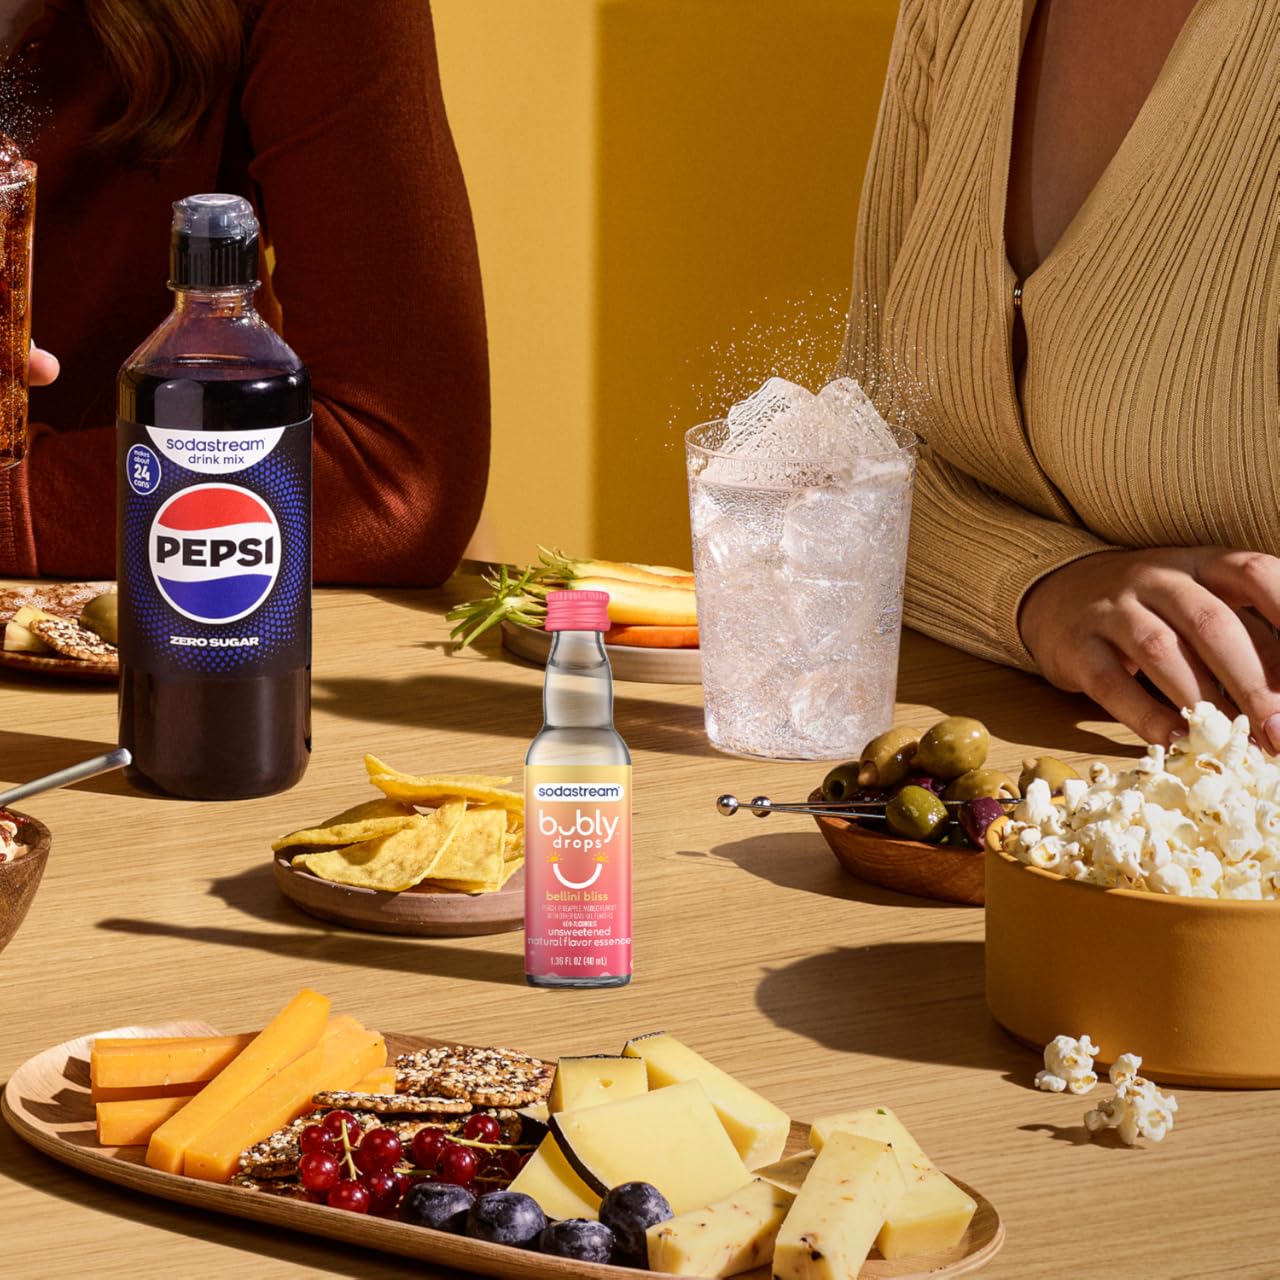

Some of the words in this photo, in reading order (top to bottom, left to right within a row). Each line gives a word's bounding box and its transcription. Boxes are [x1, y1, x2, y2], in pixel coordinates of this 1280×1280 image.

[166, 438, 265, 452] sodastream
[133, 450, 150, 458] makes
[188, 454, 220, 464] drink
[223, 454, 245, 464] mix
[133, 456, 150, 465] about
[133, 464, 150, 480] 24
[156, 535, 274, 567] PEPSI
[169, 635, 208, 646] ZERO
[208, 636, 259, 647] SUGAR
[538, 785, 619, 797] sodastream
[552, 835, 602, 853] drops
[545, 891, 581, 901] bellini
[583, 891, 609, 901] bliss
[547, 926, 611, 936] unsweetened
[527, 937, 562, 946] natural
[563, 936, 592, 947] flavor
[593, 937, 632, 946] essence
